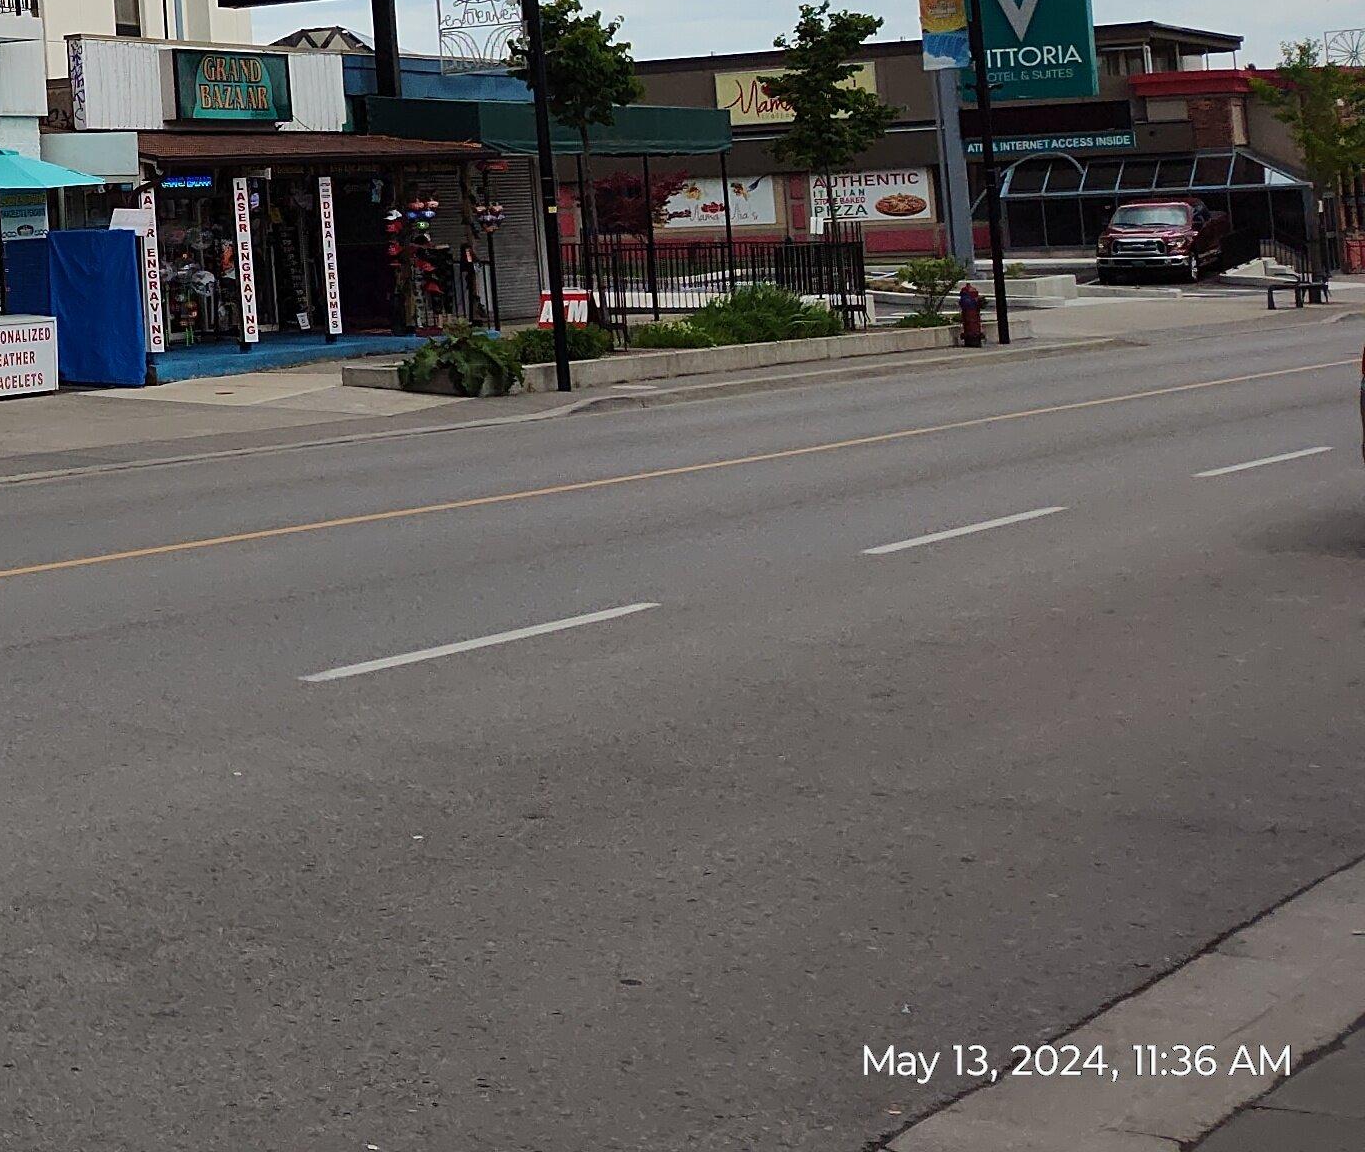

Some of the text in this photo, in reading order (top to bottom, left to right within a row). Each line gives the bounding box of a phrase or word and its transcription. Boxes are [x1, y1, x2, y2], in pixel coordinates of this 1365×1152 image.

[986, 43, 1083, 68] ITTORIA
[202, 55, 263, 83] GRAND
[986, 68, 1075, 83] OTEL & SUITES
[199, 84, 269, 110] BAZAAR
[1000, 138, 1051, 152] INTERNET
[1051, 136, 1094, 149] ACCESS
[1096, 134, 1132, 147] INSIDE
[813, 172, 919, 188] AUTHENTIC
[813, 189, 865, 199] ITLIAN
[840, 196, 866, 204] BAKED
[814, 204, 869, 217] PIZZA
[323, 201, 334, 249] DUBAI
[236, 182, 256, 335] LASER ENGRAVING
[147, 248, 163, 346] ENGRAVING
[327, 252, 340, 330] PERFUMES
